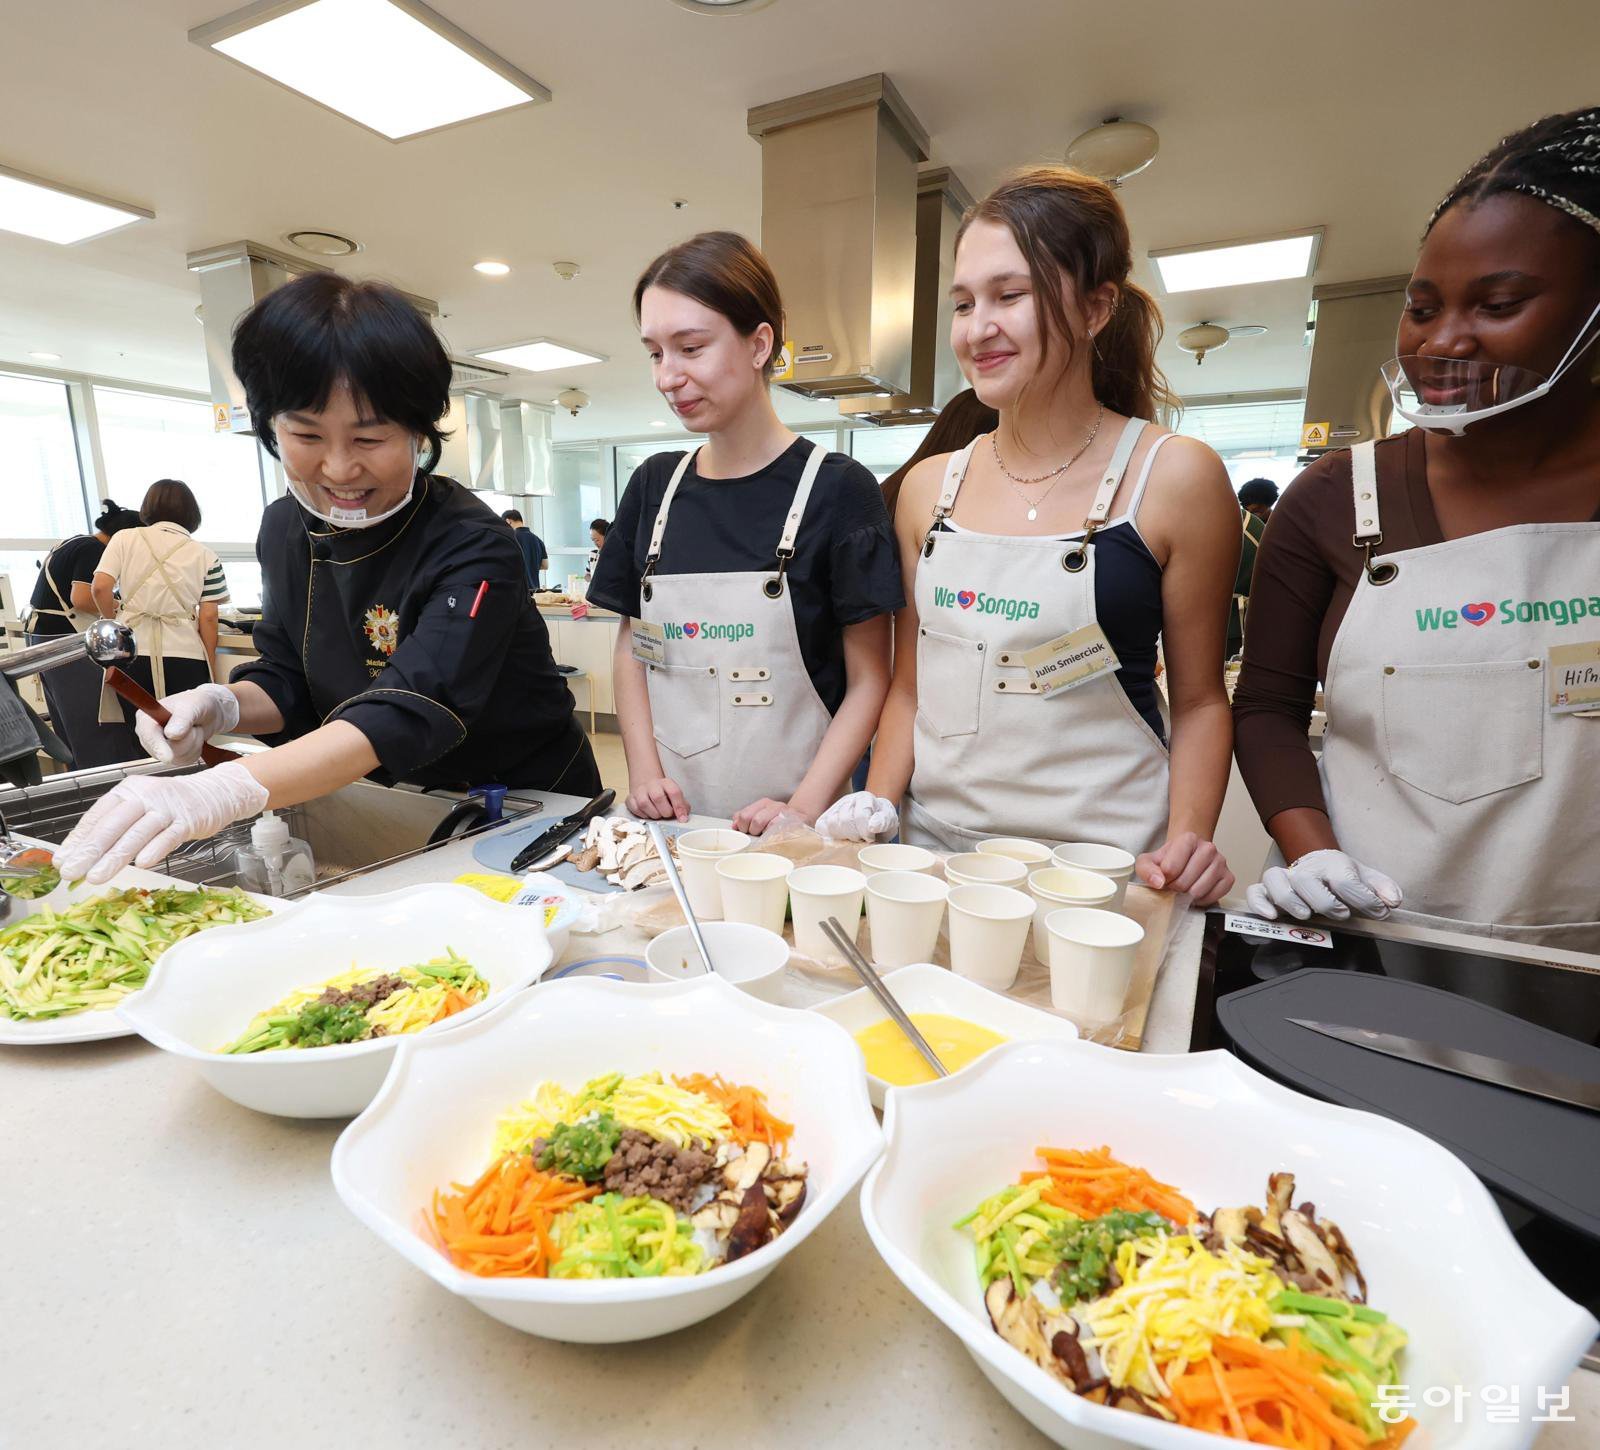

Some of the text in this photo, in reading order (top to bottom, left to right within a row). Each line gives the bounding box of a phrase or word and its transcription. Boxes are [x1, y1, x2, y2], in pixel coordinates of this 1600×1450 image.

[934, 586, 1040, 621] We Songpa
[664, 622, 683, 640] We
[700, 622, 754, 642] Songpa
[1415, 607, 1458, 631] We
[1034, 664, 1057, 678] Julia
[1057, 642, 1106, 669] Smierciak
